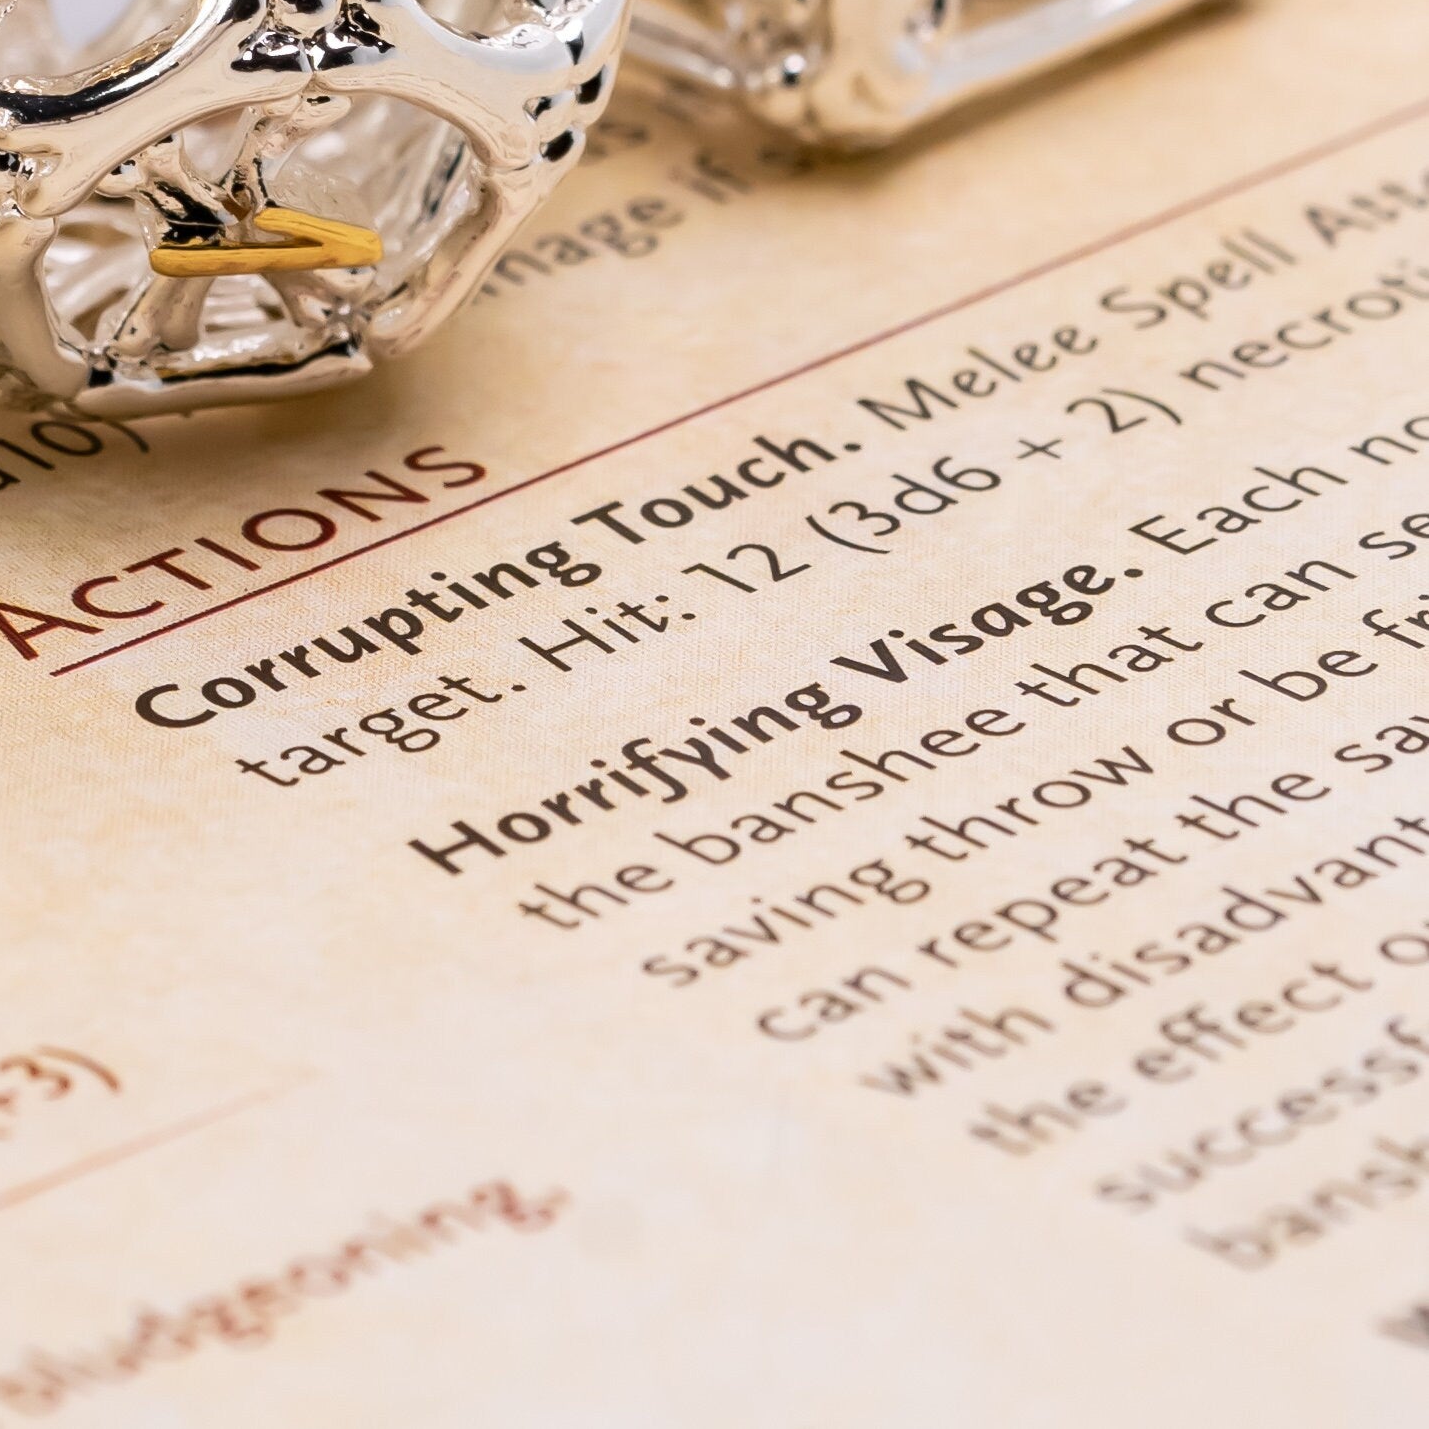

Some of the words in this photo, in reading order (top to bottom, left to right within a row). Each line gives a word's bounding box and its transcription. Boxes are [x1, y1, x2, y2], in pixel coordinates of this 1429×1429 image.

[135, 537, 602, 729] Corrupting
[571, 431, 862, 544] Touch.
[856, 316, 1098, 431] Melee
[1099, 226, 1298, 330] Spell
[1304, 167, 1429, 248] Att
[237, 671, 527, 788] target.
[518, 592, 697, 672] Hit:
[681, 542, 812, 594] 12
[804, 454, 1001, 555] (3d6
[1015, 432, 1064, 463] +
[1065, 388, 1182, 434] 2)
[407, 680, 863, 876] Horrifying
[830, 558, 1144, 687] Visage.
[1127, 465, 1349, 555] Each
[518, 856, 675, 931] the
[653, 699, 1027, 867] banshee
[1015, 625, 1204, 708] that
[1205, 559, 1359, 629] can
[642, 857, 932, 988] saving
[904, 744, 1155, 863] throw
[1167, 697, 1257, 747] or
[1238, 649, 1379, 702] be
[756, 961, 911, 1043] can
[918, 838, 1189, 968] repeat
[1175, 773, 1332, 841] the
[860, 1000, 1053, 1101] with
[968, 1078, 1130, 1157] the
[1132, 961, 1374, 1083] effect
[1378, 922, 1429, 966] o
